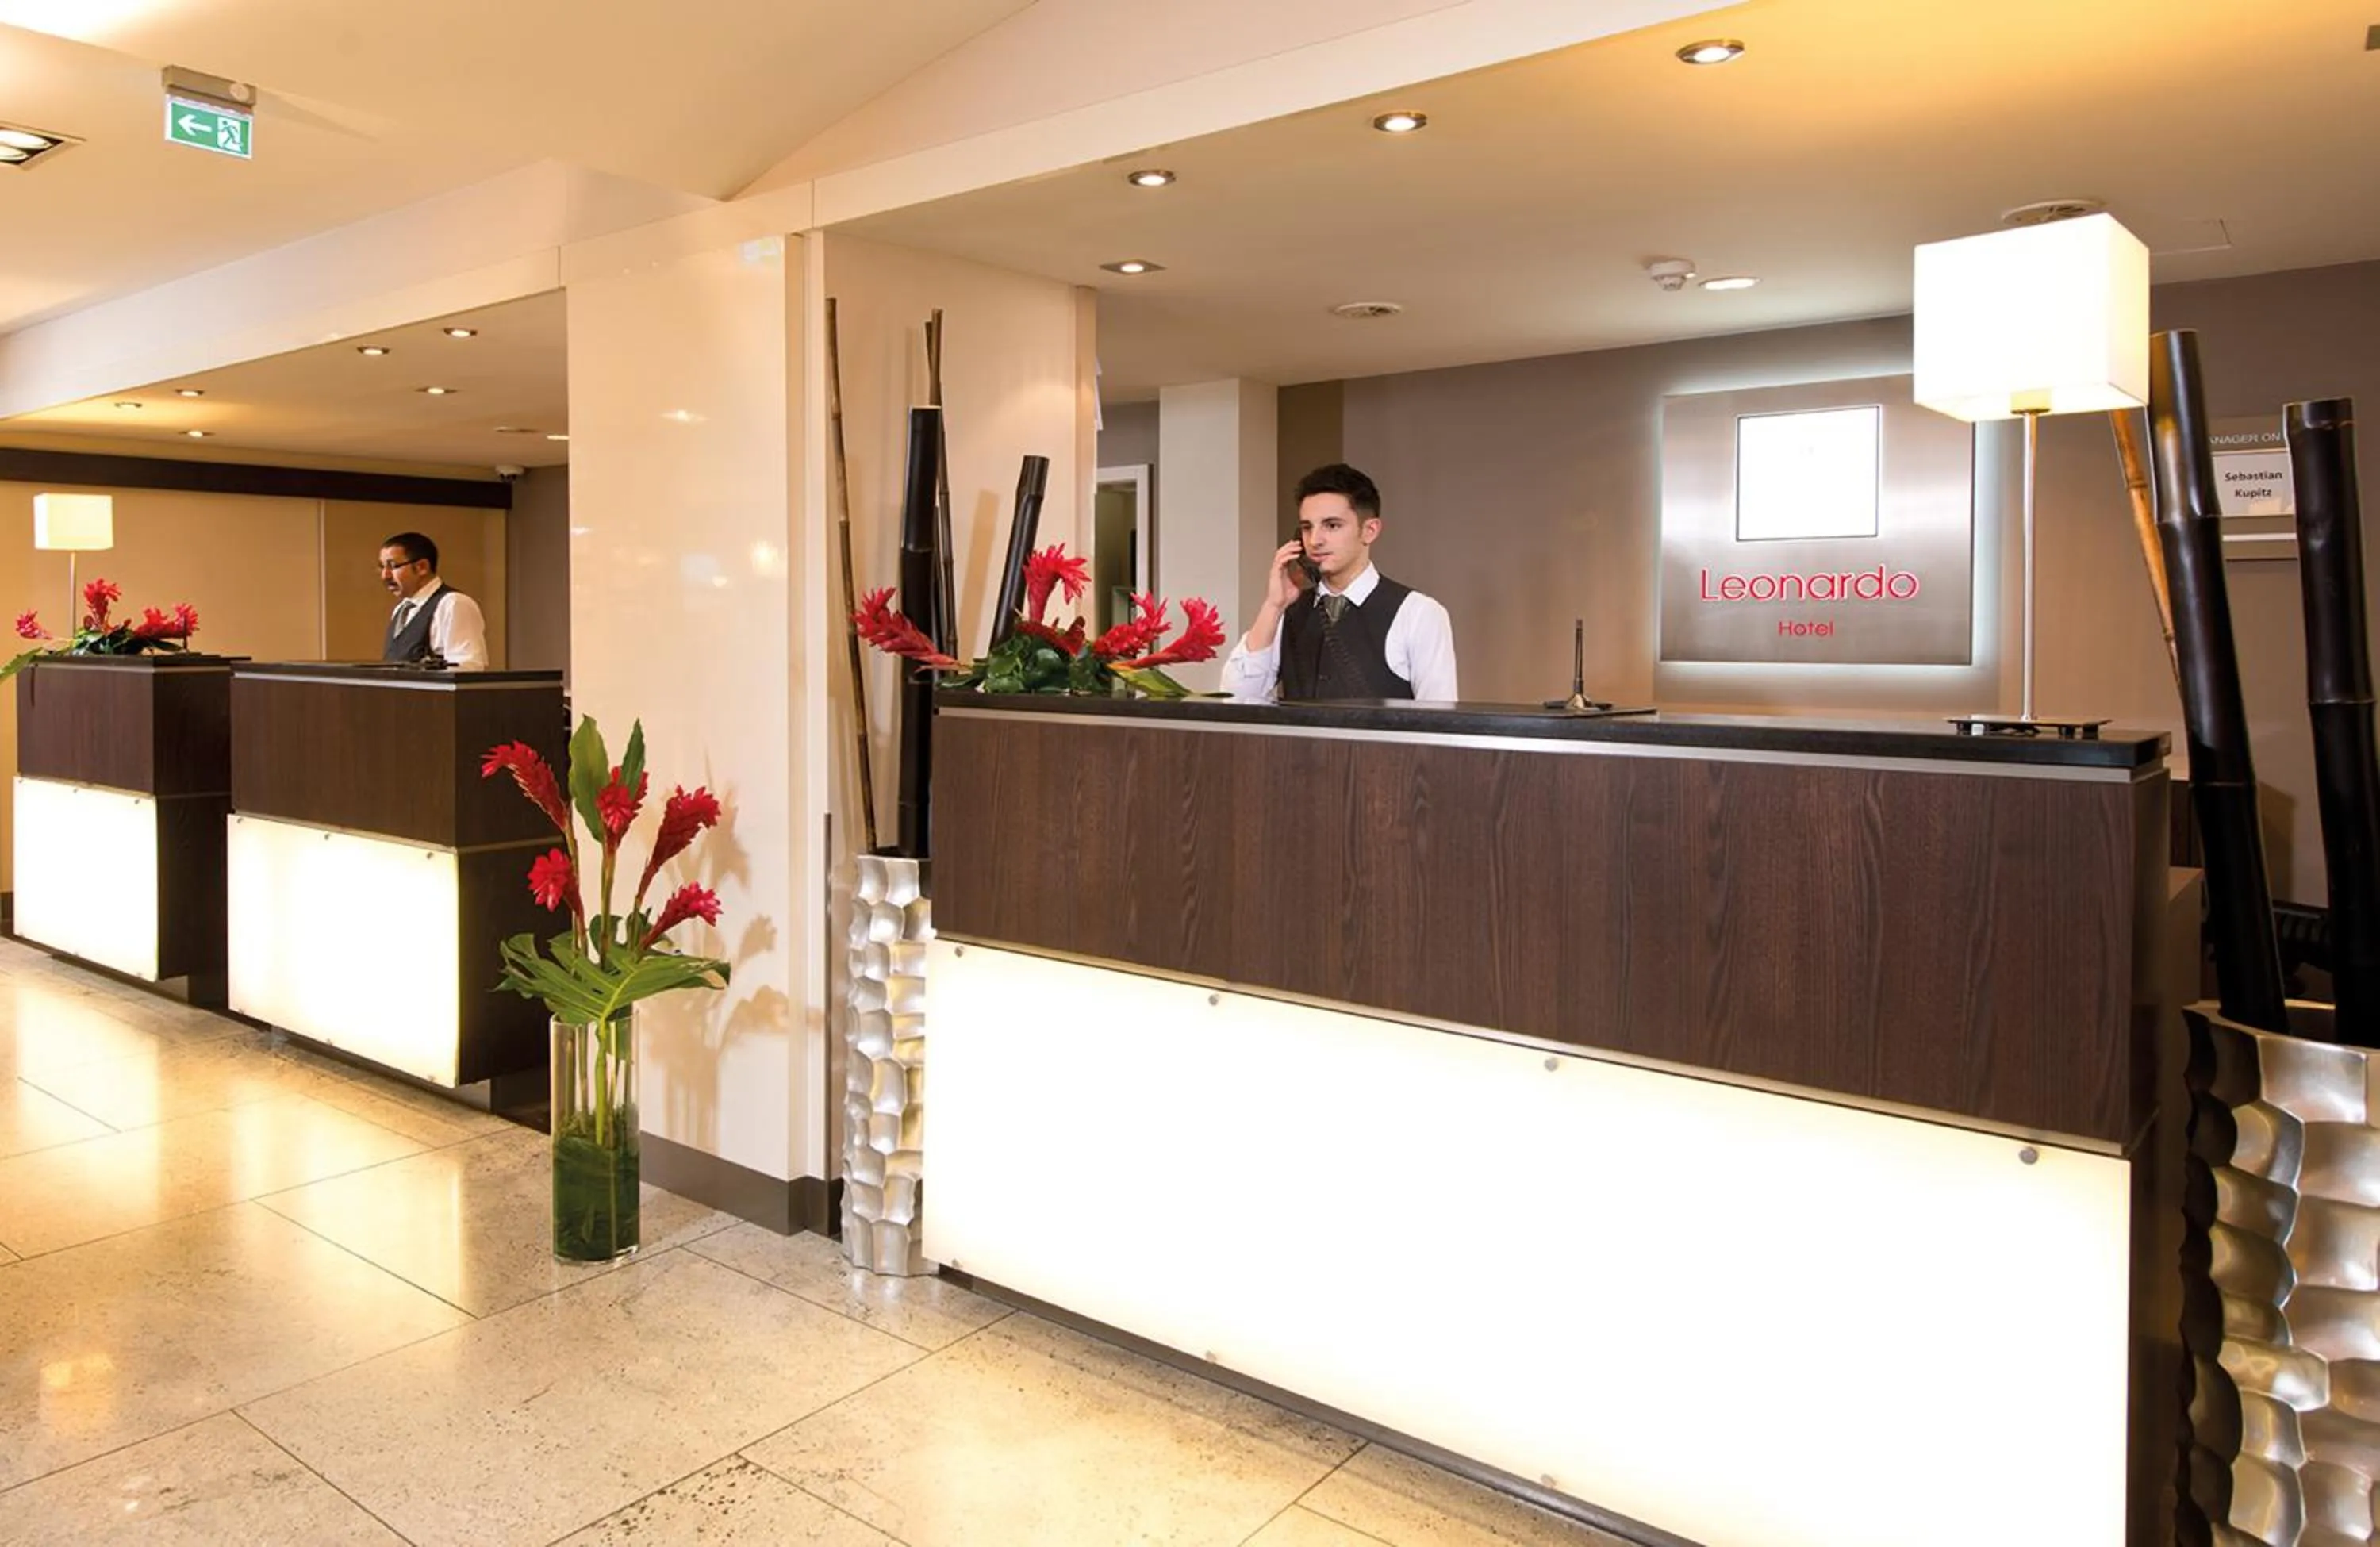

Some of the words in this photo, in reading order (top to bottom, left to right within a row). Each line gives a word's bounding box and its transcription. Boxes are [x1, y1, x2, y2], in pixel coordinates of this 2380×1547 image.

[2261, 432, 2281, 443] ON
[2225, 471, 2282, 482] Sebastian
[2234, 488, 2271, 498] Kupitz
[1700, 565, 1919, 601] Leonardo
[1778, 621, 1834, 635] Hotel
